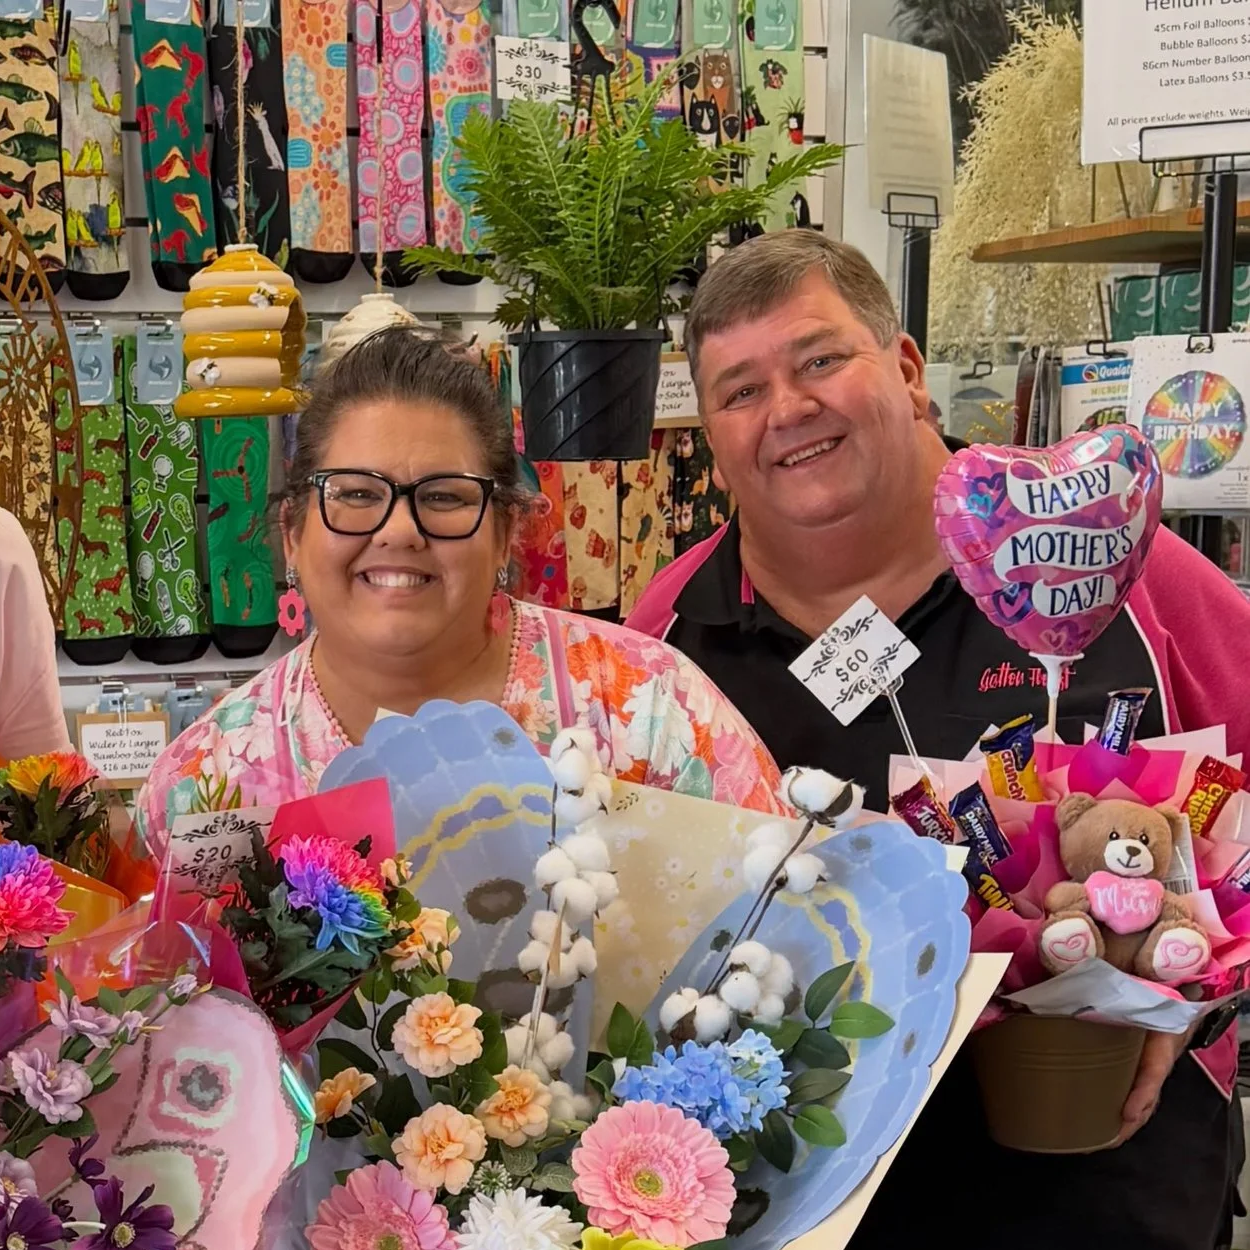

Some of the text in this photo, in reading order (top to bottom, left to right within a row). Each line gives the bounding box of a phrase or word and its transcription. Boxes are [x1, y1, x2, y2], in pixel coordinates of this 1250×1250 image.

[1154, 22, 1181, 33] 45cm
[1183, 20, 1201, 31] Foil
[1203, 17, 1245, 29] Balloons
[1160, 38, 1194, 51] Bubble
[1197, 35, 1239, 48] Balloons
[1142, 54, 1250, 71] 86cm Number Balloon
[515, 64, 542, 79] $30
[1159, 77, 1185, 88] Latex
[1188, 74, 1230, 85] Balloons
[1107, 117, 1119, 127] All
[1121, 115, 1149, 127] prices
[1151, 111, 1186, 123] exclude
[1099, 363, 1131, 379] Qualat
[661, 401, 682, 414] pair
[1168, 402, 1223, 419] HAPPY
[1153, 422, 1237, 441] BIRTHDAY
[1025, 464, 1111, 514] HAPPY
[1011, 525, 1134, 567] MOTHER'S
[1049, 575, 1105, 616] DAY!
[835, 648, 869, 683] $60
[978, 662, 1025, 692] Gatton
[105, 728, 124, 738] Red
[88, 740, 117, 749] Wider
[129, 739, 161, 750] Larger
[93, 749, 159, 760] Bamboo Socks
[103, 763, 119, 772] $16
[130, 762, 150, 773] pair
[966, 811, 988, 840] DAIRY
[981, 838, 999, 864] MILK
[193, 845, 232, 863] $20
